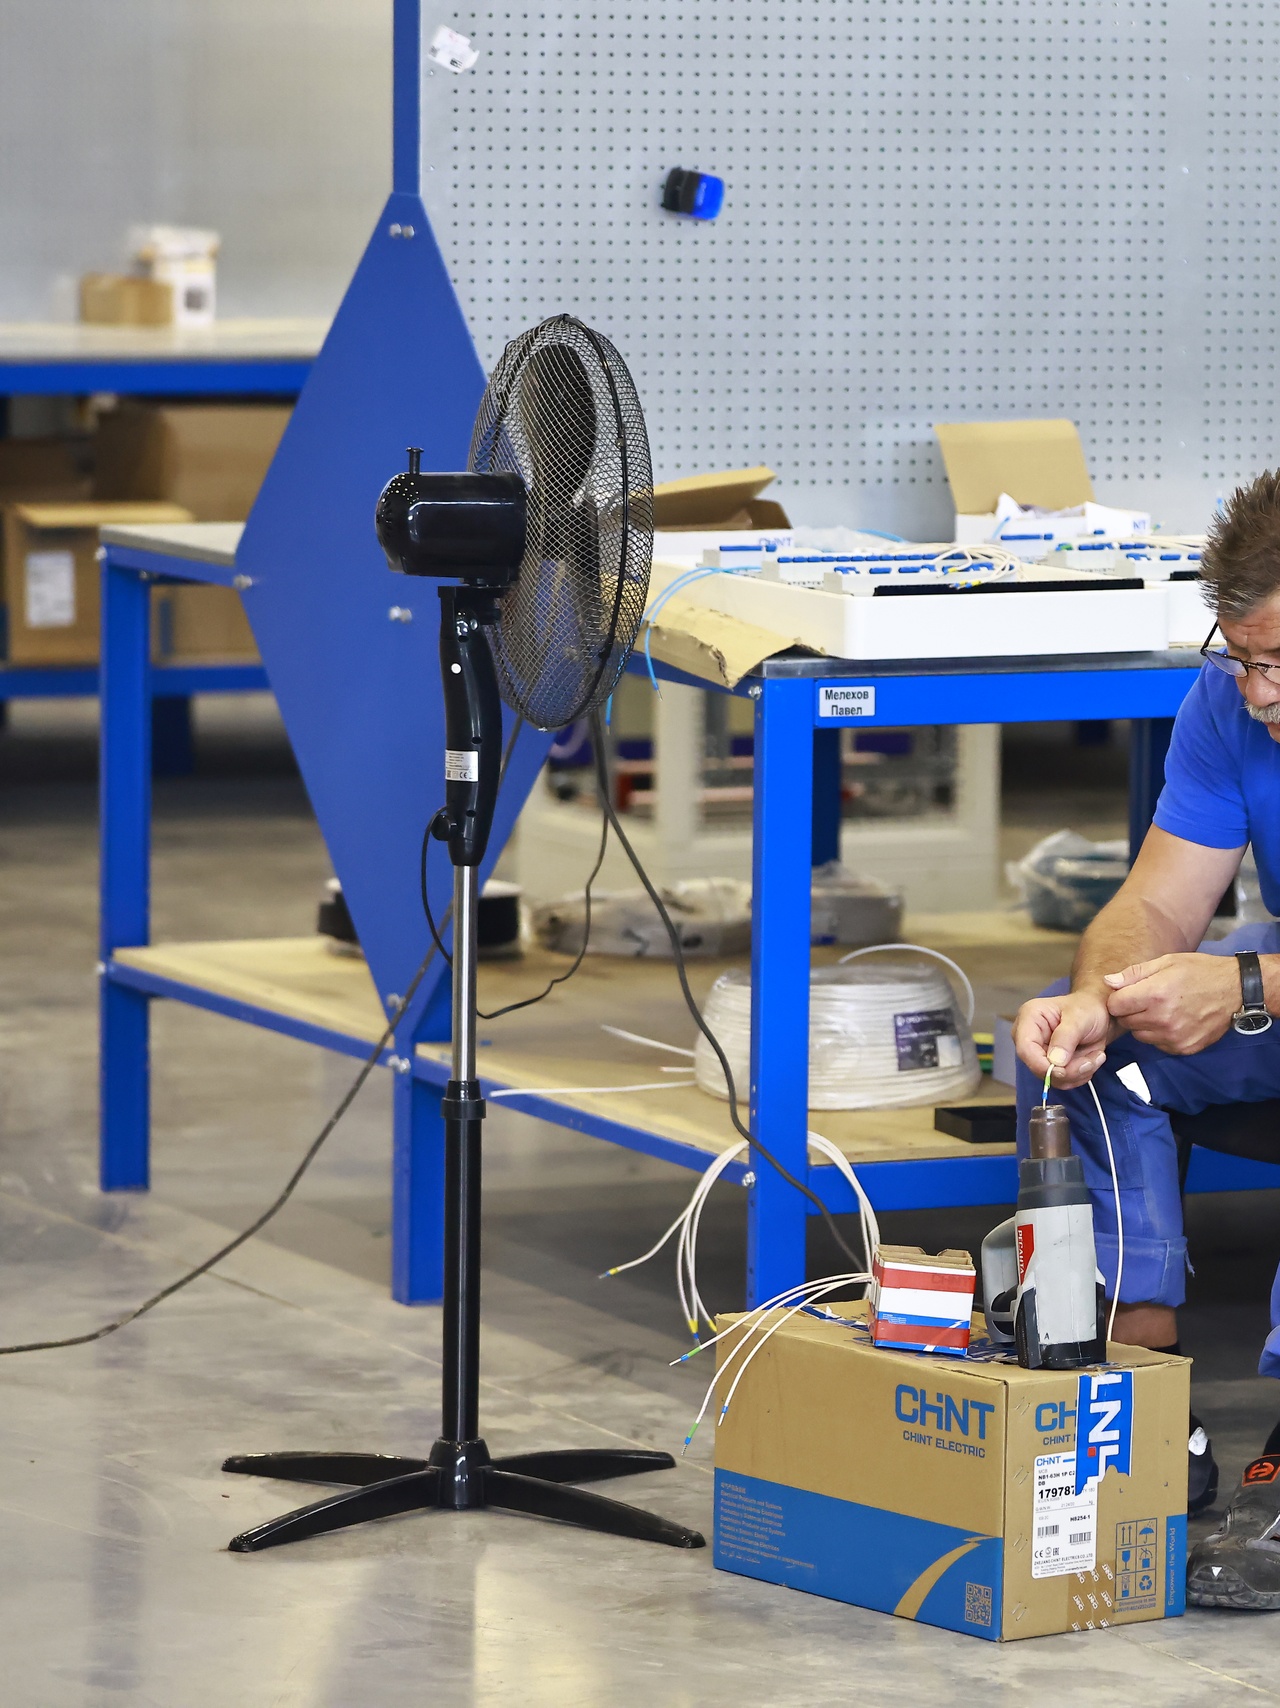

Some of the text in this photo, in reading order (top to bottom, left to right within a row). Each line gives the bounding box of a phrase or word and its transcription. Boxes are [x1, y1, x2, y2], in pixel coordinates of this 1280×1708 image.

[825, 689, 869, 700] Мелехов
[831, 705, 863, 716] Павел
[903, 1430, 986, 1458] CHINT ELECTRIC
[1043, 1434, 1071, 1446] CHINT
